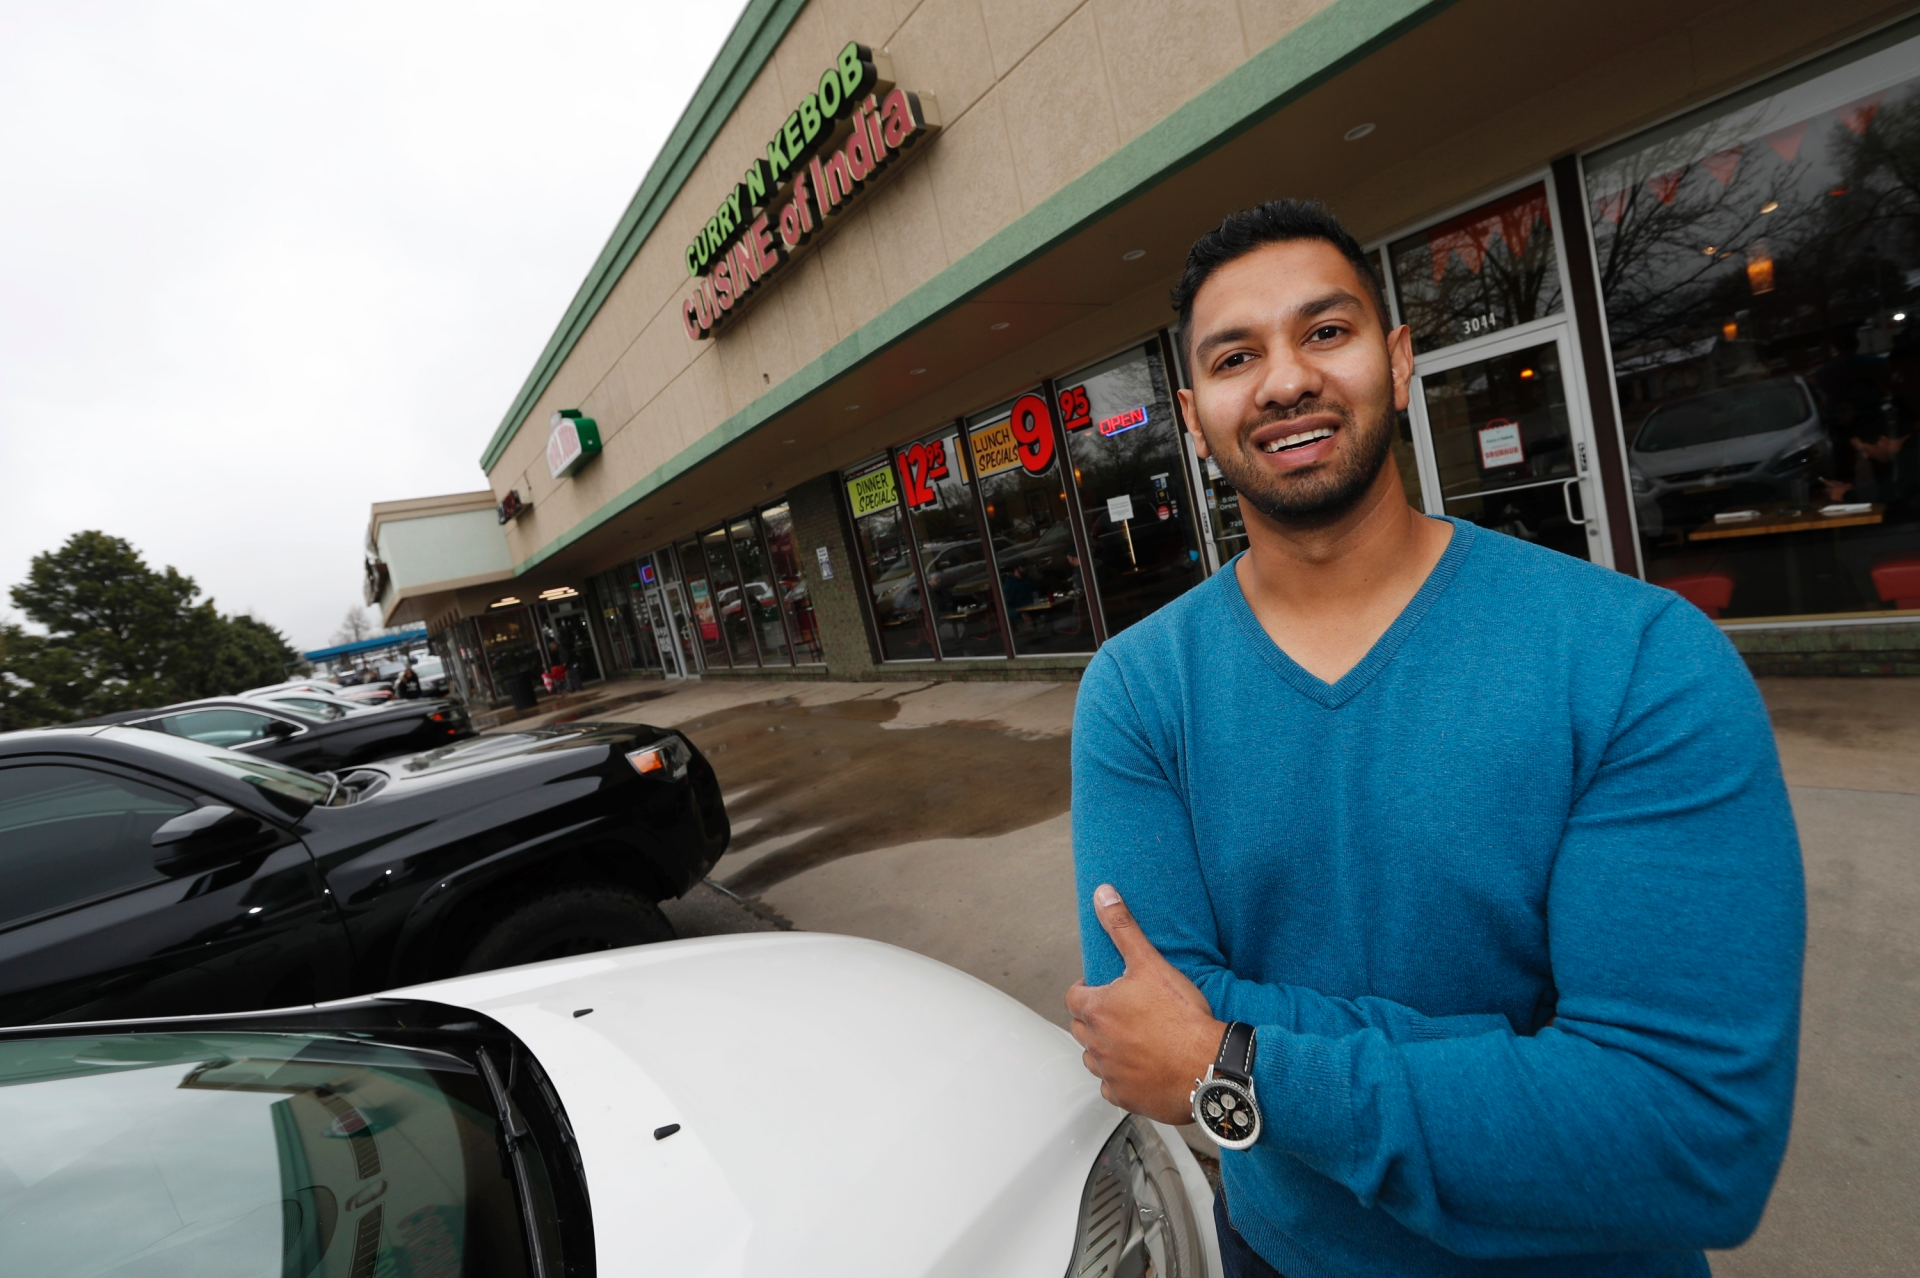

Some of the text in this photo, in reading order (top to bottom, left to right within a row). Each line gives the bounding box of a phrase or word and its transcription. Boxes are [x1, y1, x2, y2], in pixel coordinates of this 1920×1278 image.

[685, 40, 864, 277] CURRY N KEBOB
[682, 88, 917, 341] CUISINE of India
[1462, 312, 1497, 335] 3044
[1098, 407, 1144, 435] OPEN
[973, 427, 1010, 454] LUNCH
[978, 444, 1019, 472] SPECIALS
[855, 472, 889, 496] DINNER
[858, 486, 897, 513] SPECIALS
[1219, 502, 1237, 511] OPEN
